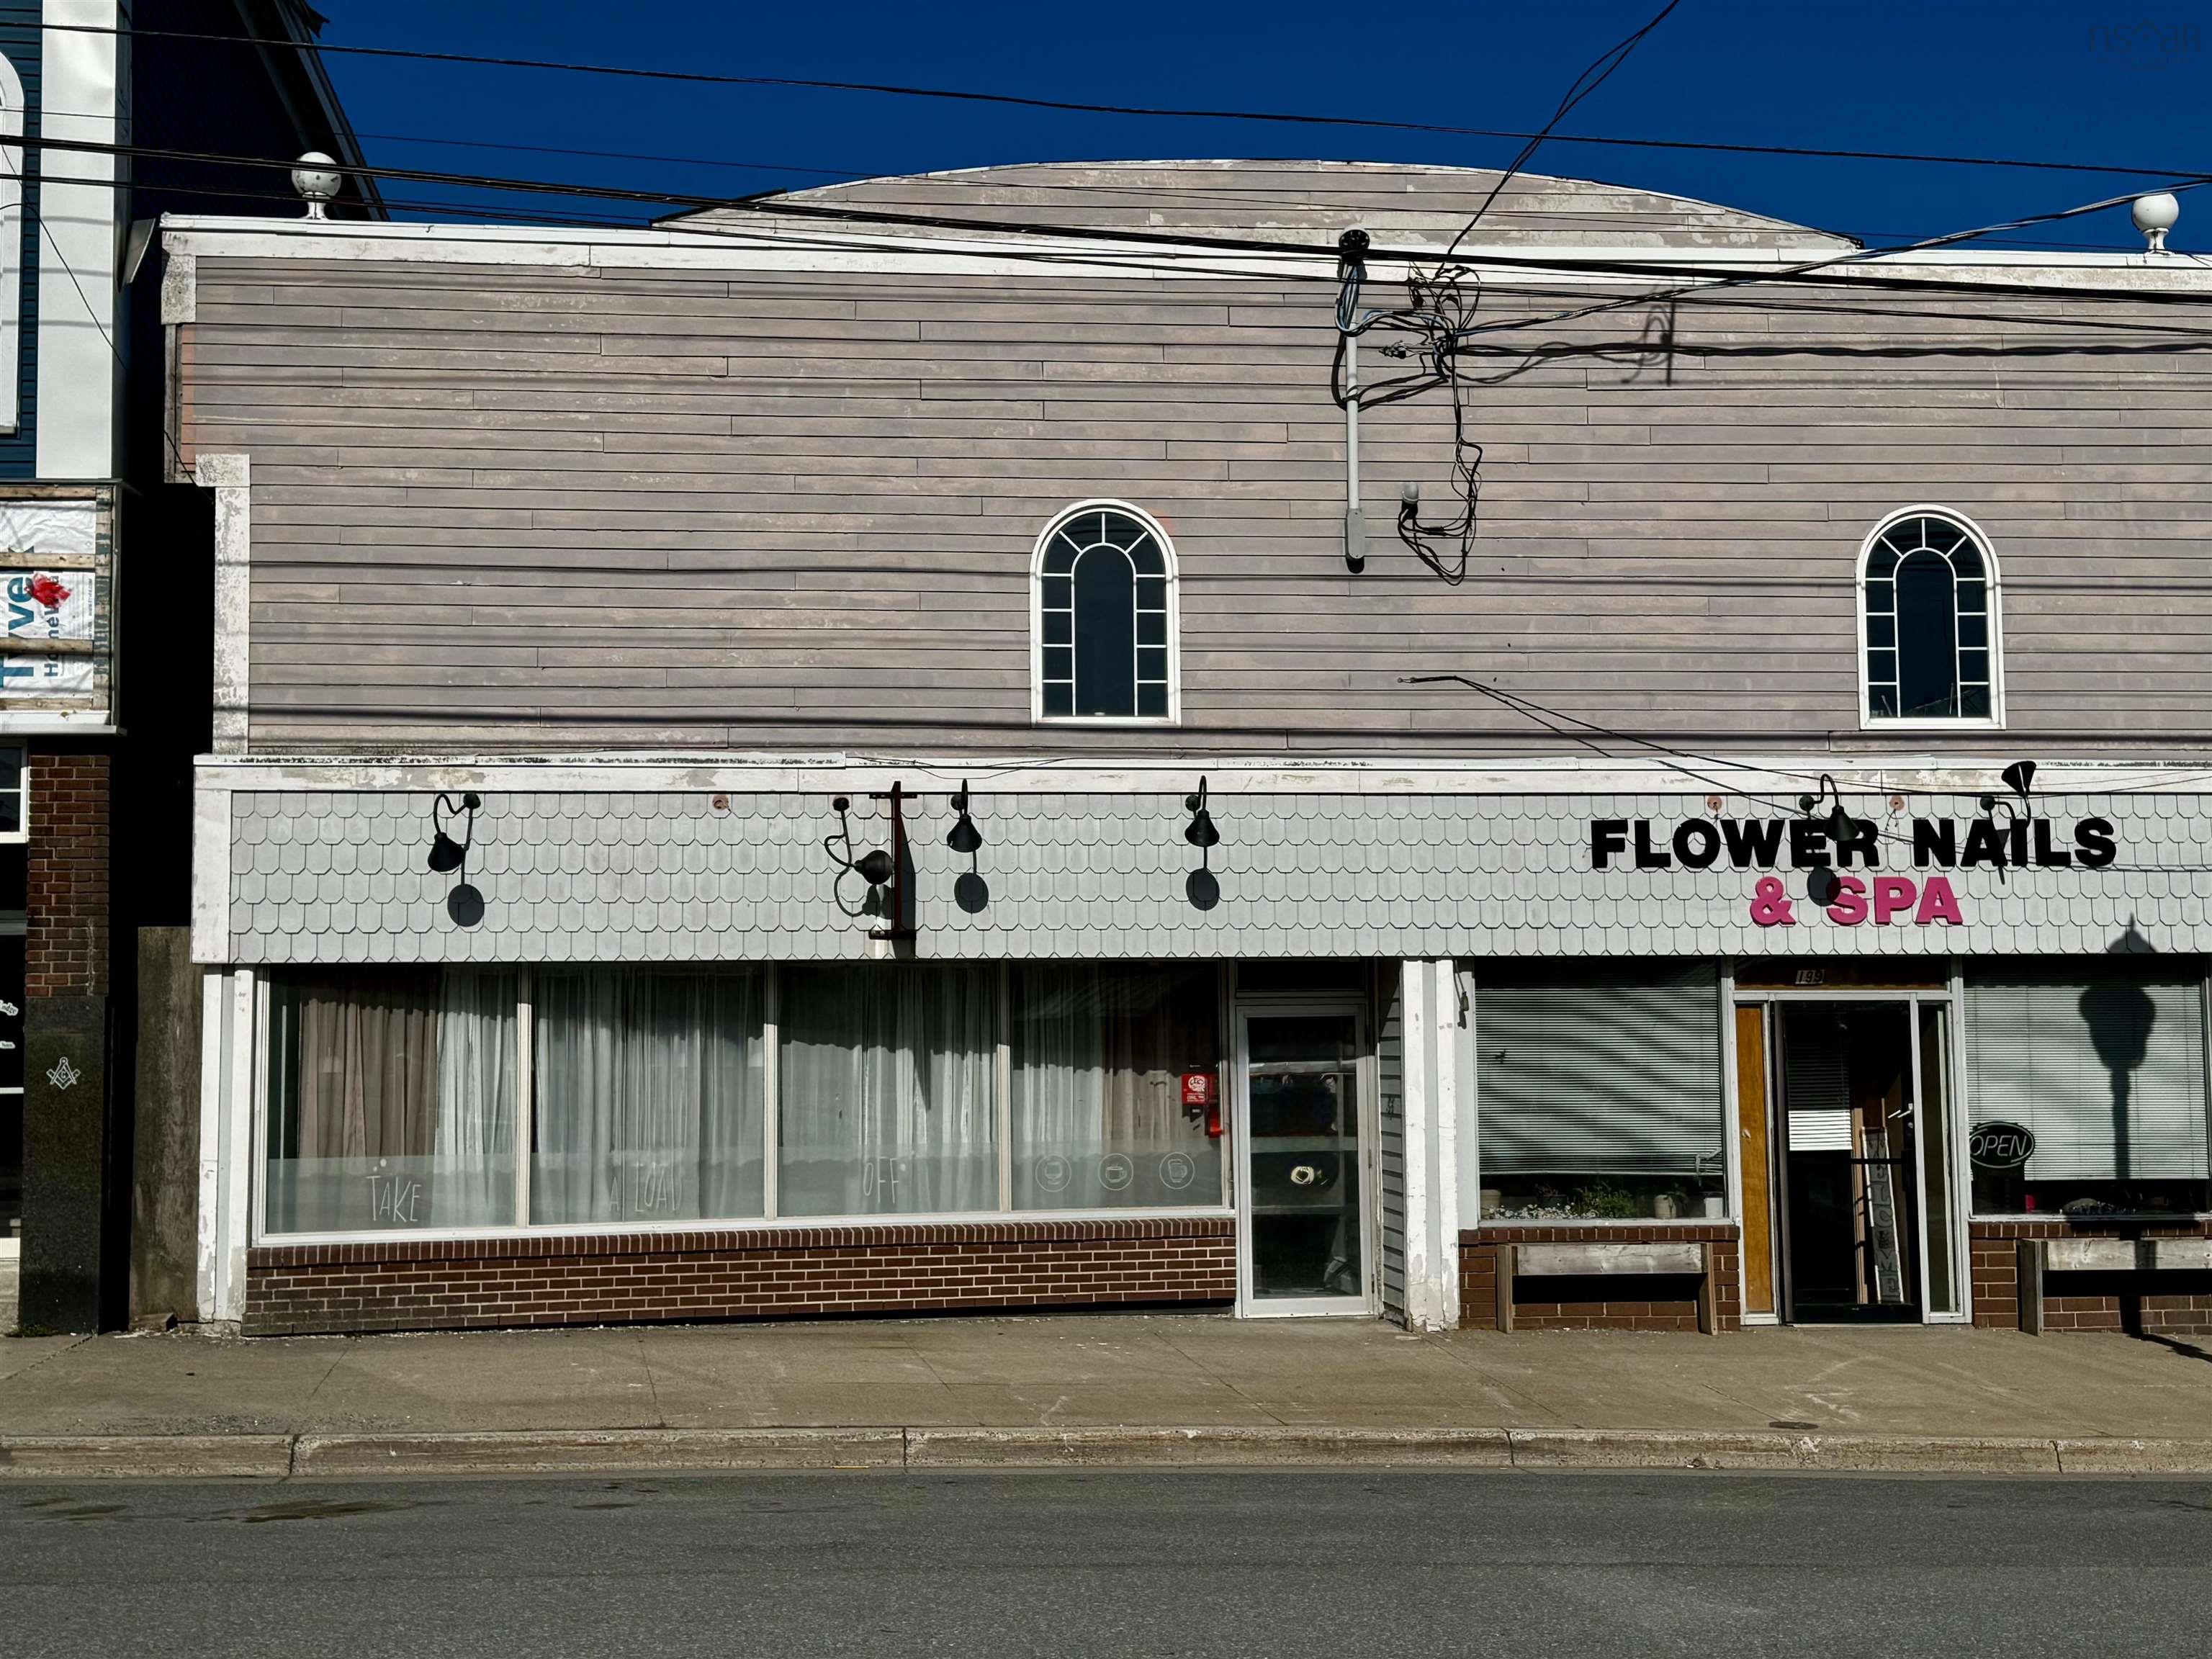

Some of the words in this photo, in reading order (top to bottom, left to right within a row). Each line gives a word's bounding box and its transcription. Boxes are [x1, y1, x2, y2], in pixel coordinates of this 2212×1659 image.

[0, 546, 35, 688] Tve
[1591, 818, 1880, 868] FLOWER
[1913, 817, 2117, 868] NAILS
[1750, 876, 1796, 927] &
[1826, 876, 1964, 926] SPA
[1969, 1135, 2027, 1156] OPEN
[364, 1175, 422, 1223] TAKE
[608, 1176, 619, 1212] A
[863, 1156, 900, 1205] OFF
